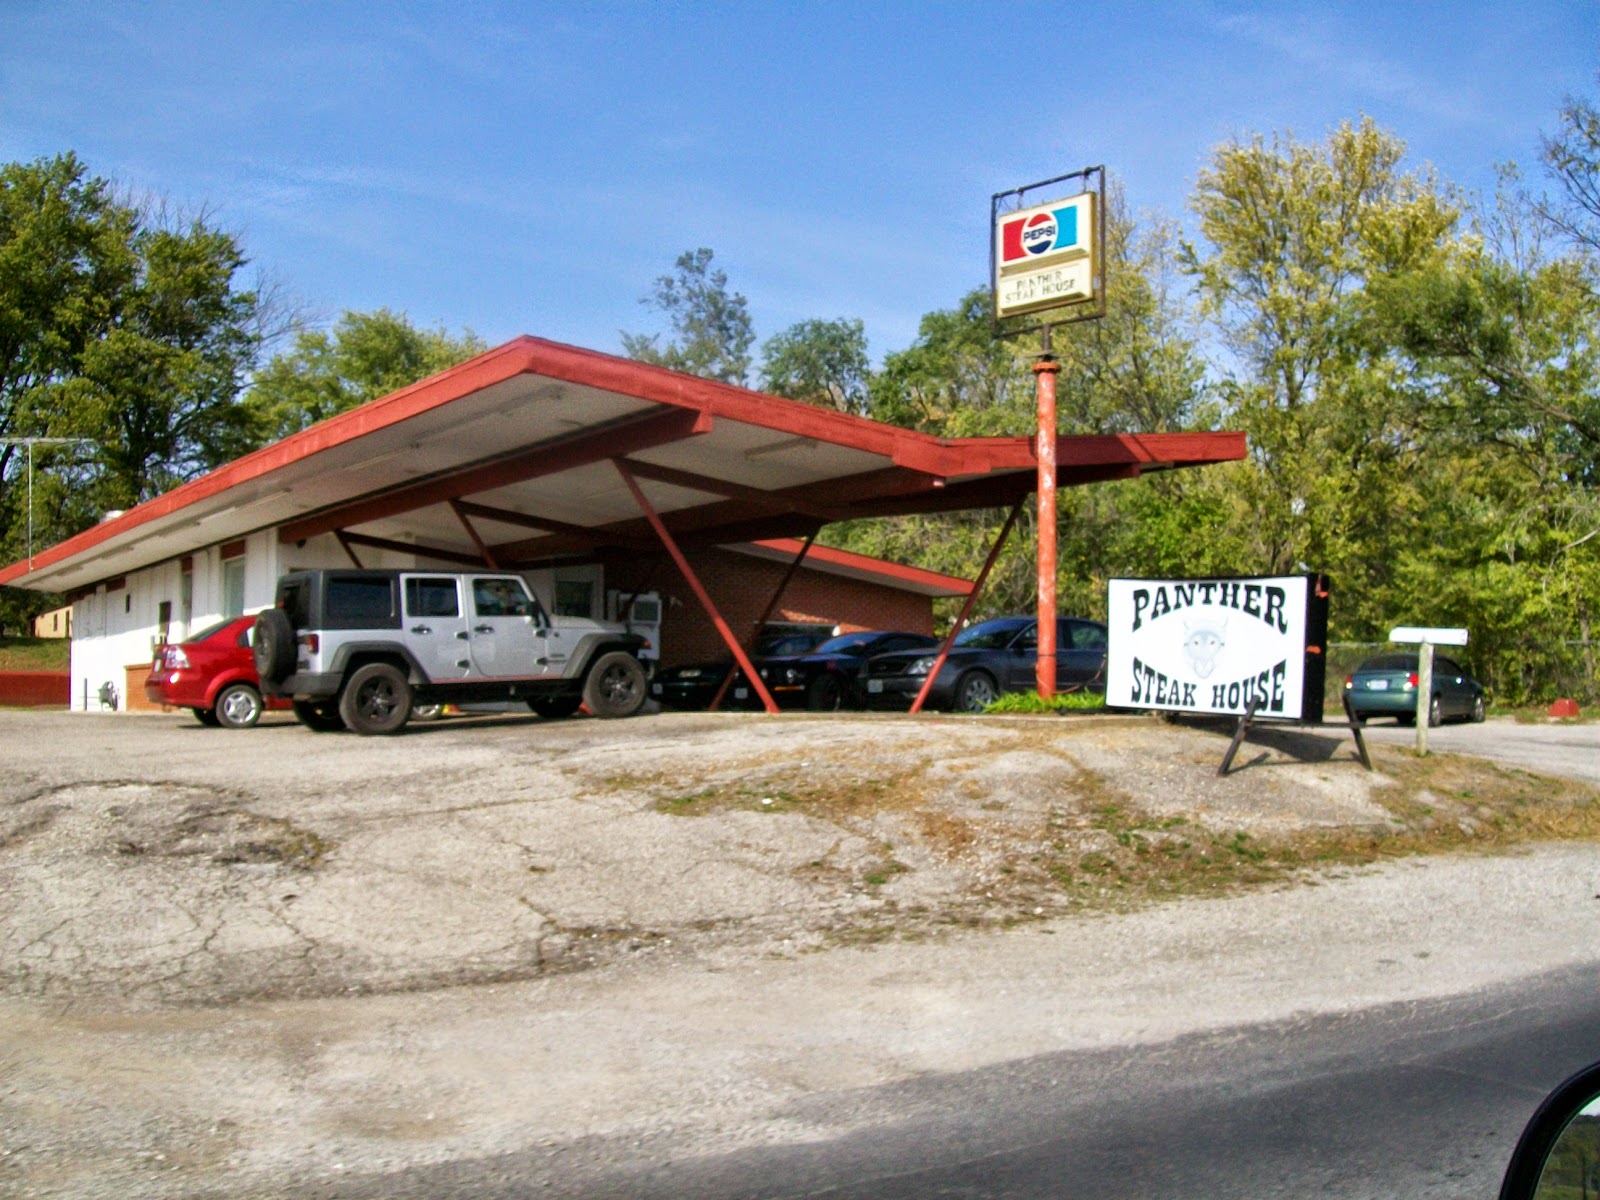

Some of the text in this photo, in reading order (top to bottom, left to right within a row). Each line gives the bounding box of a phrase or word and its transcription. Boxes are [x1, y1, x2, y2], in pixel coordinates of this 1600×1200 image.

[1023, 225, 1056, 242] PEPSI
[1016, 270, 1062, 290] PNTHR
[1132, 583, 1288, 635] PANTHER
[1131, 656, 1286, 712] STEAK HOUSE
